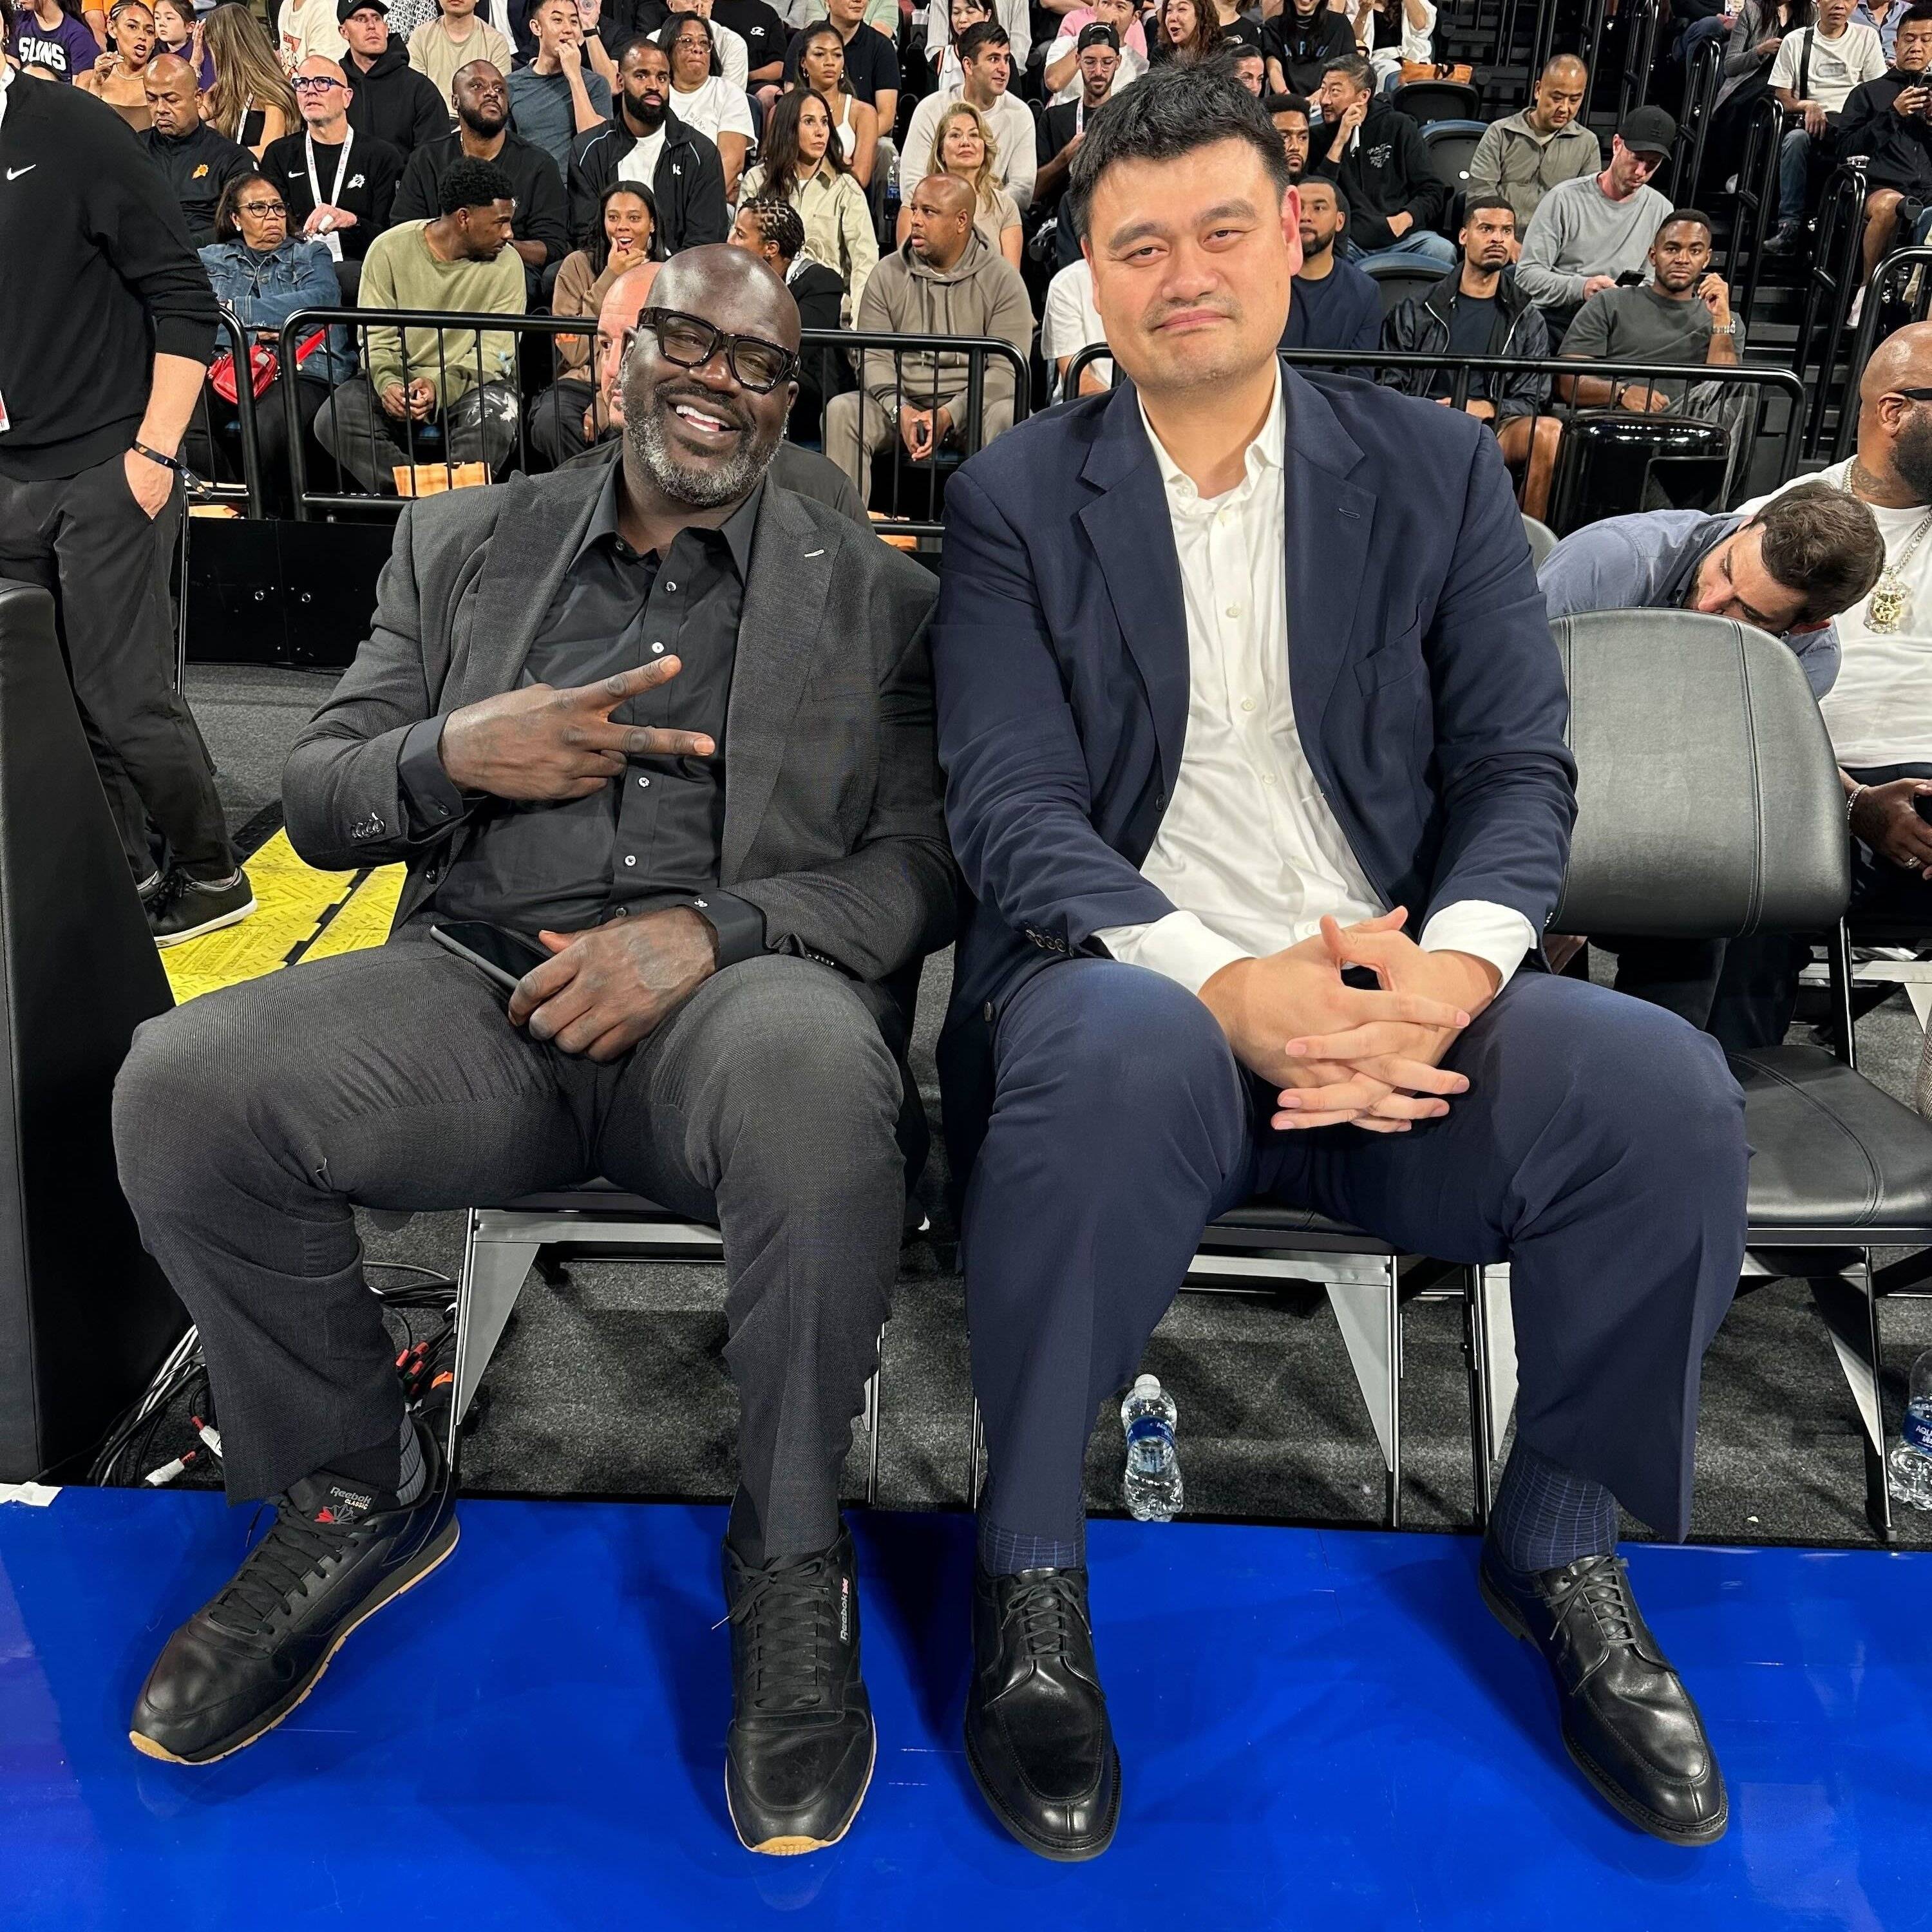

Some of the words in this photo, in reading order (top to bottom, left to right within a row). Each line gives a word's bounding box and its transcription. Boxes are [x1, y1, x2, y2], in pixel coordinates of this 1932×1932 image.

[19, 37, 66, 71] SUNS
[330, 1486, 372, 1504] Reebok
[344, 1498, 369, 1510] CLASSIC
[840, 1593, 849, 1641] Reebok
